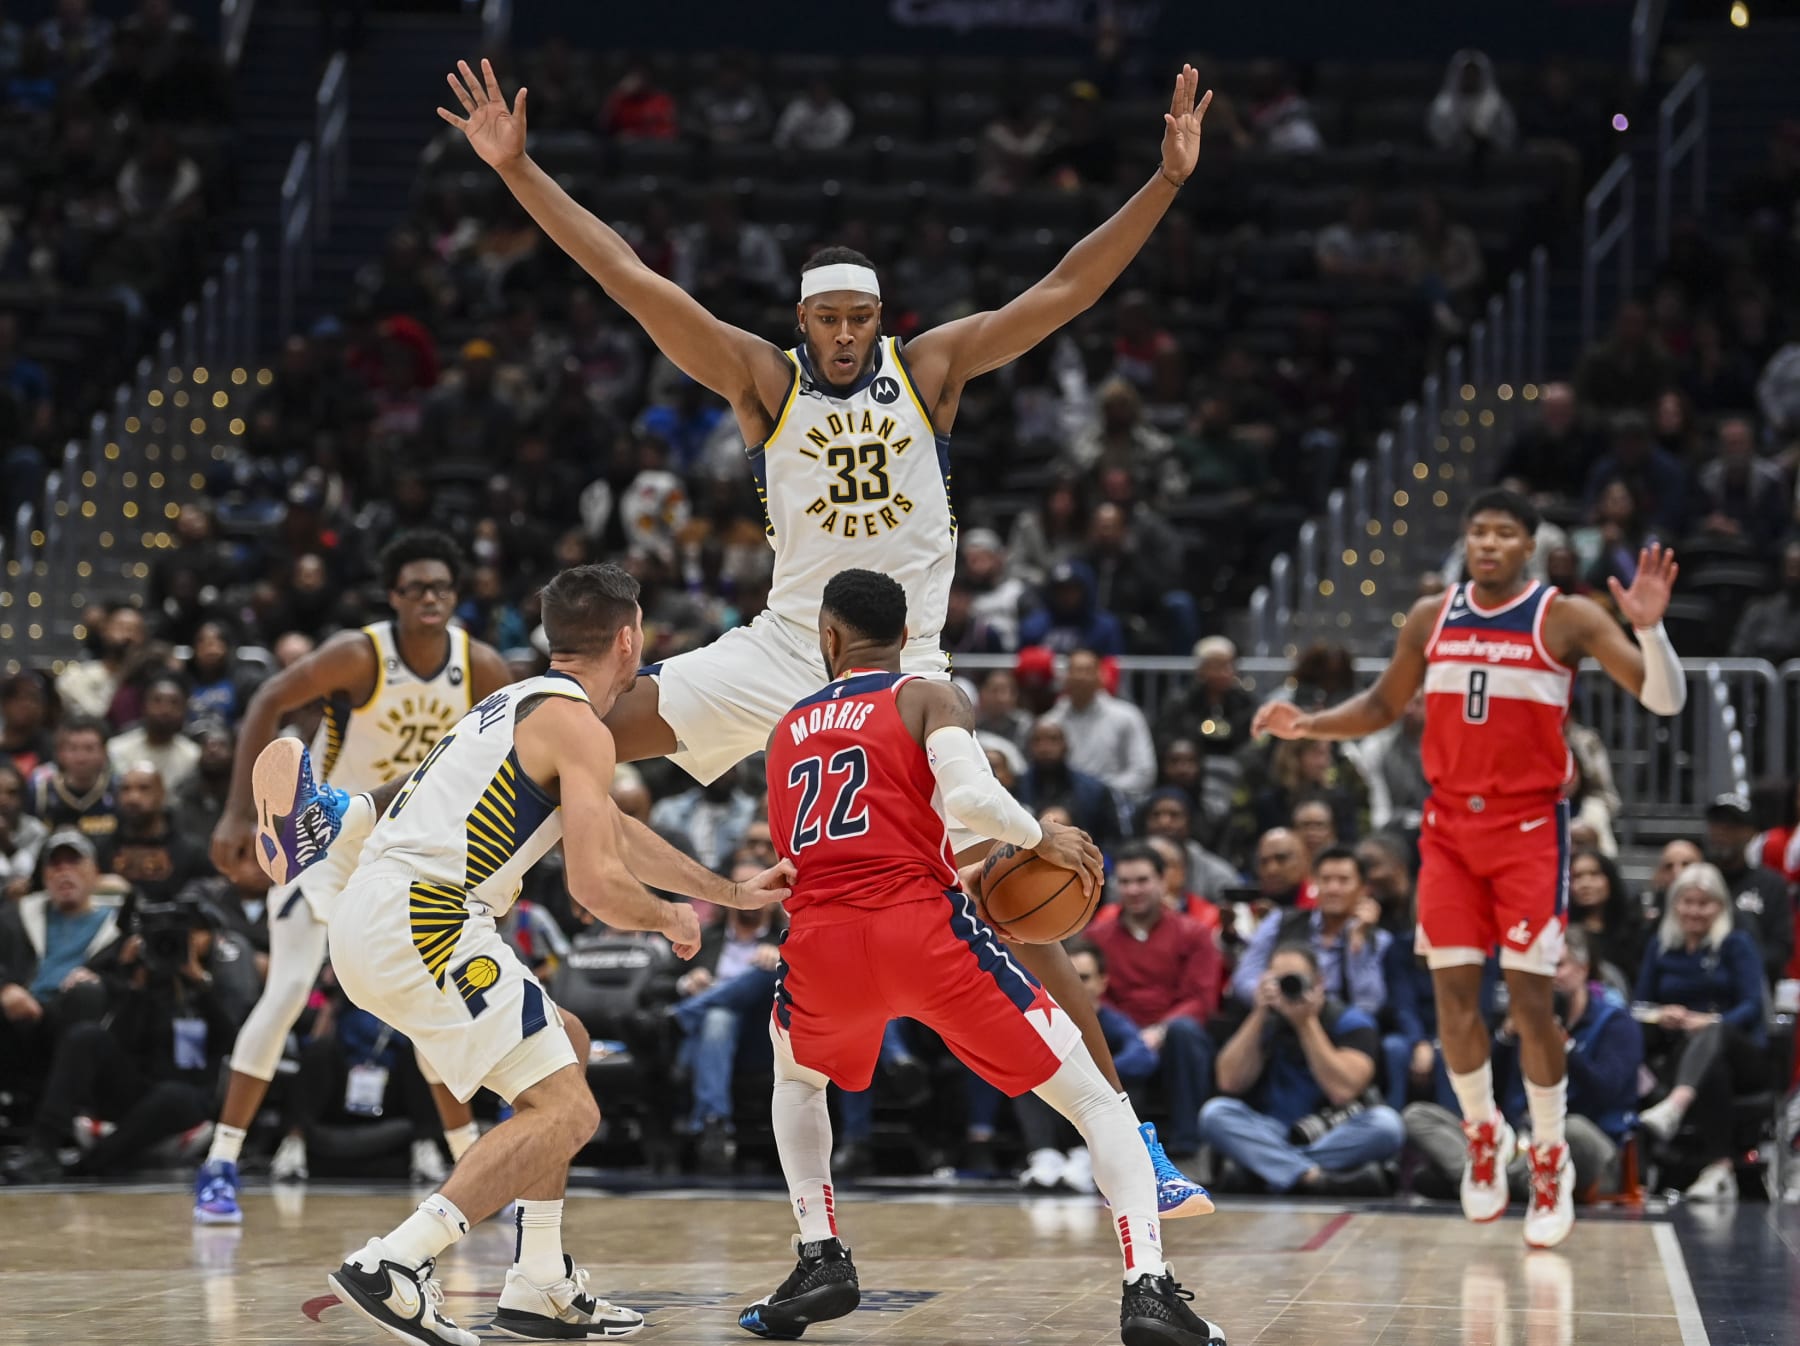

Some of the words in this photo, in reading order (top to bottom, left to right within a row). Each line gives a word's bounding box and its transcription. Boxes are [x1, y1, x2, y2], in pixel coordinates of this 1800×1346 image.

[799, 409, 912, 461] INDIANA
[827, 442, 892, 504] 33
[805, 492, 915, 538] PACERS
[1437, 634, 1533, 662] washington
[1463, 669, 1491, 725] 8
[394, 725, 438, 764] 25
[790, 702, 875, 746] MORRIS
[787, 745, 870, 855] 22
